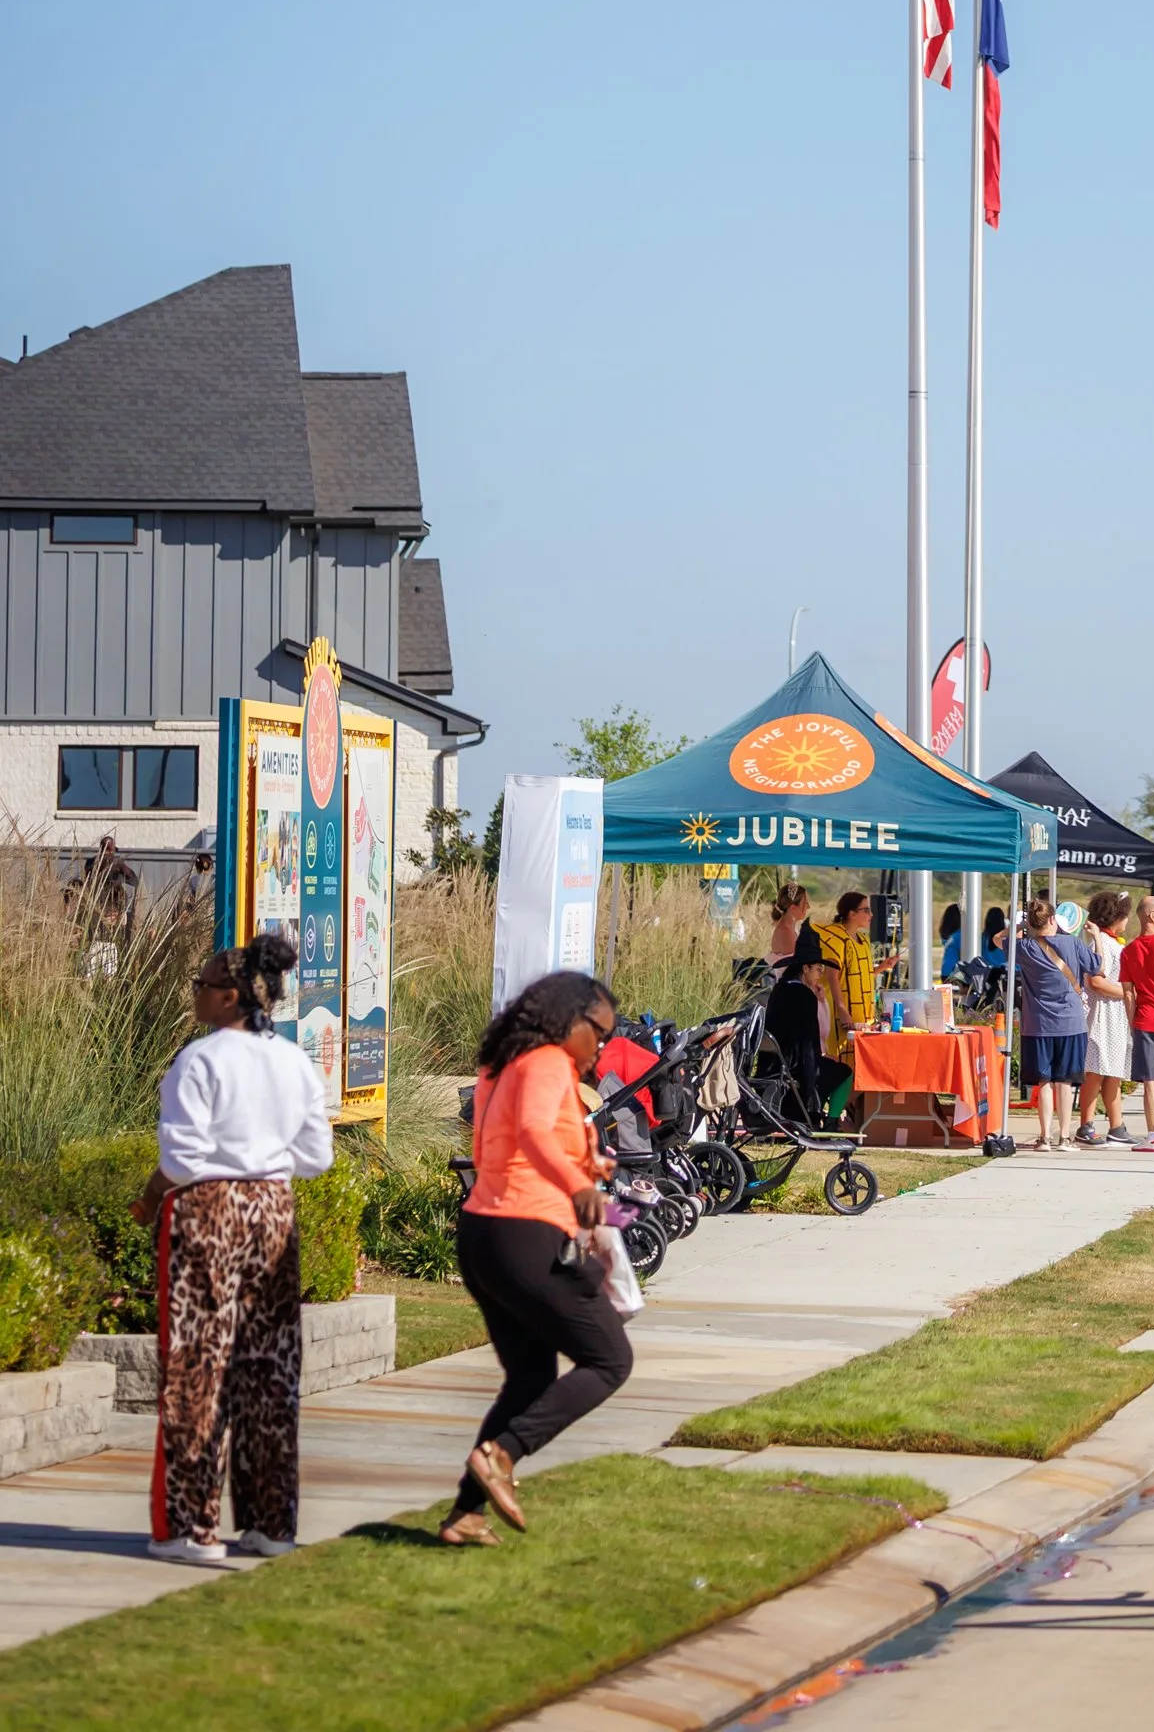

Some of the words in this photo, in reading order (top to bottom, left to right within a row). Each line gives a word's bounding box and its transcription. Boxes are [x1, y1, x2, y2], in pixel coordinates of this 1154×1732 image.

[303, 636, 342, 691] JUBILEE
[750, 728, 784, 750] THE
[794, 722, 859, 751] JOYFUL
[261, 751, 299, 776] AMENITIES
[743, 758, 861, 789] NEIGHBORHOOD
[726, 816, 899, 851] JUBILEE
[1056, 849, 1138, 873] ann.org
